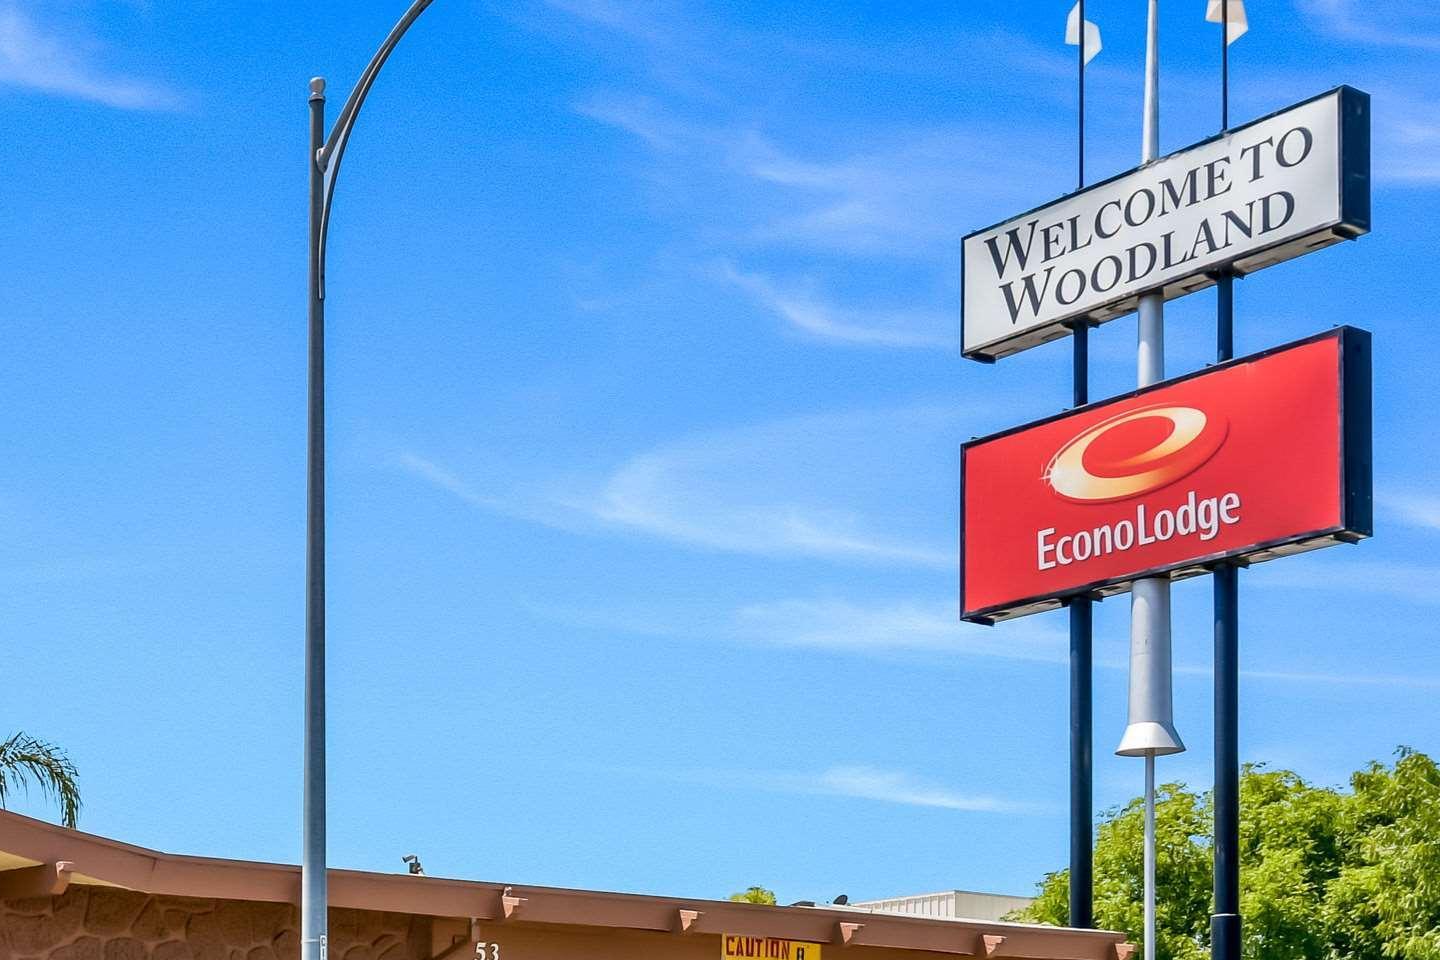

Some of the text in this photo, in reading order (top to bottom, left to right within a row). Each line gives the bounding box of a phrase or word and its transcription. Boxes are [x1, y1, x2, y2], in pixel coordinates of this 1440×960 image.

[984, 125, 1314, 280] WELCOME TO
[998, 190, 1296, 325] WOODLAND
[725, 935, 791, 960] CAUTION
